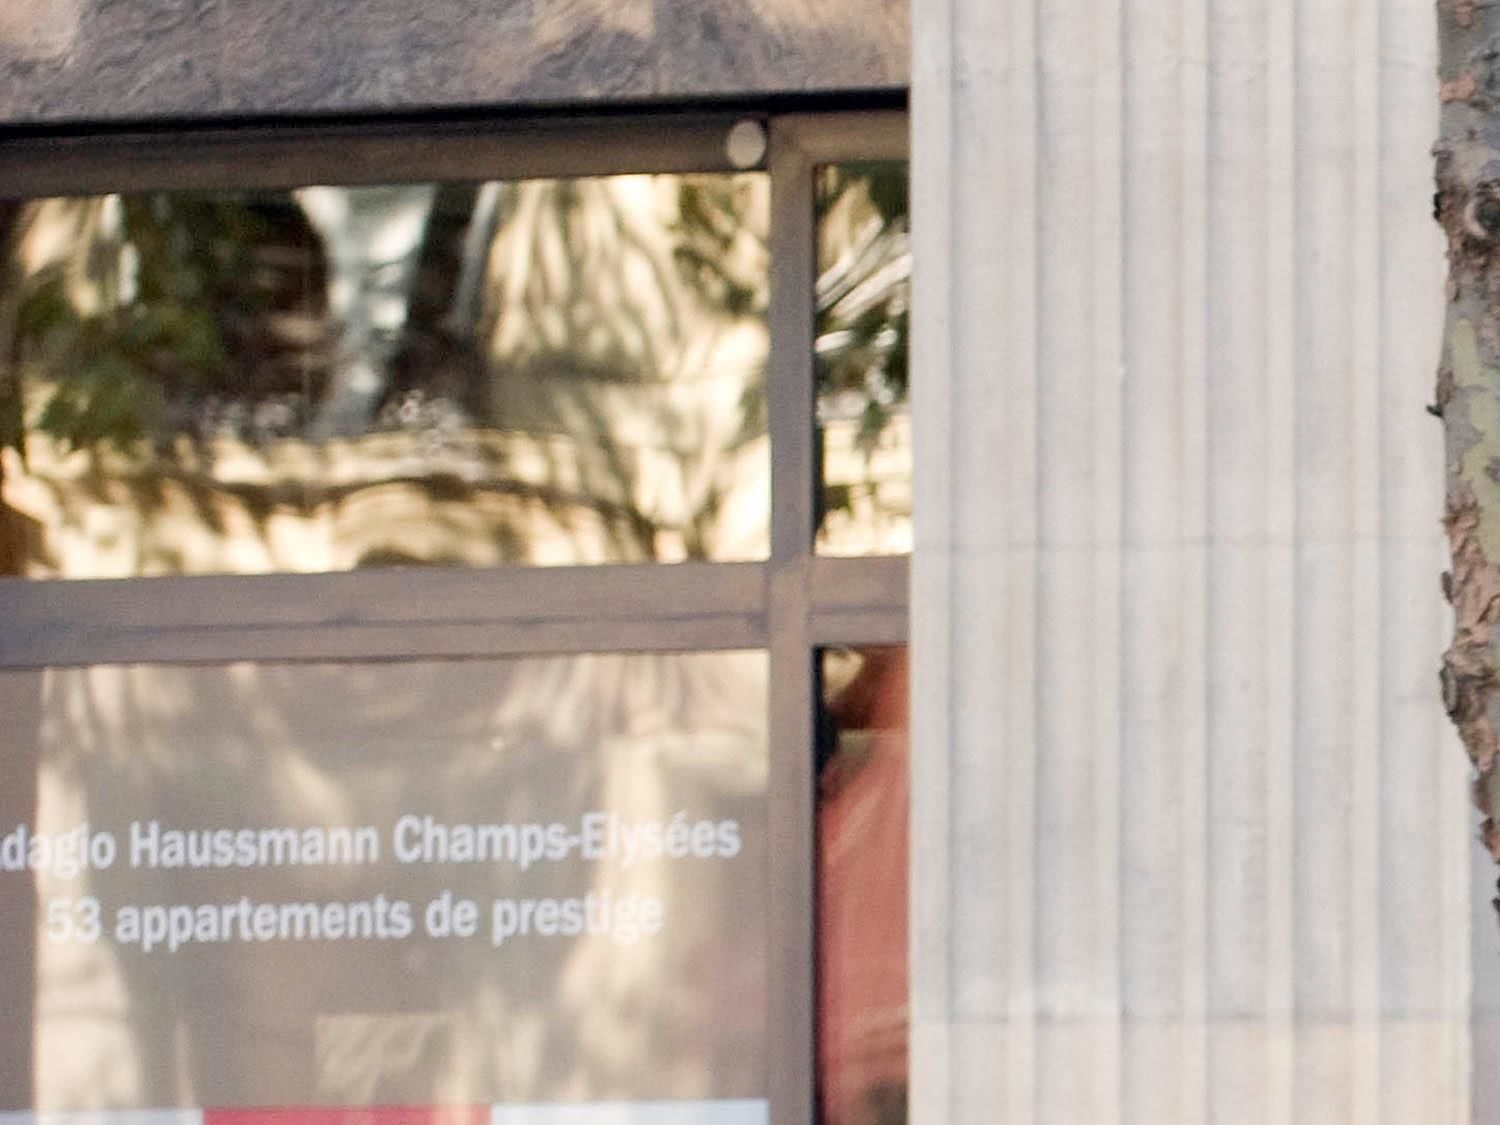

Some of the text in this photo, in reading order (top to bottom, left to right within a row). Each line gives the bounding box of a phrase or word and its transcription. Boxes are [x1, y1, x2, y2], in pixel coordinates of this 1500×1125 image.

[129, 819, 380, 870] Haussmann
[393, 809, 743, 872] Champs-Elysées
[47, 886, 665, 952] 53 appartements de prestige
